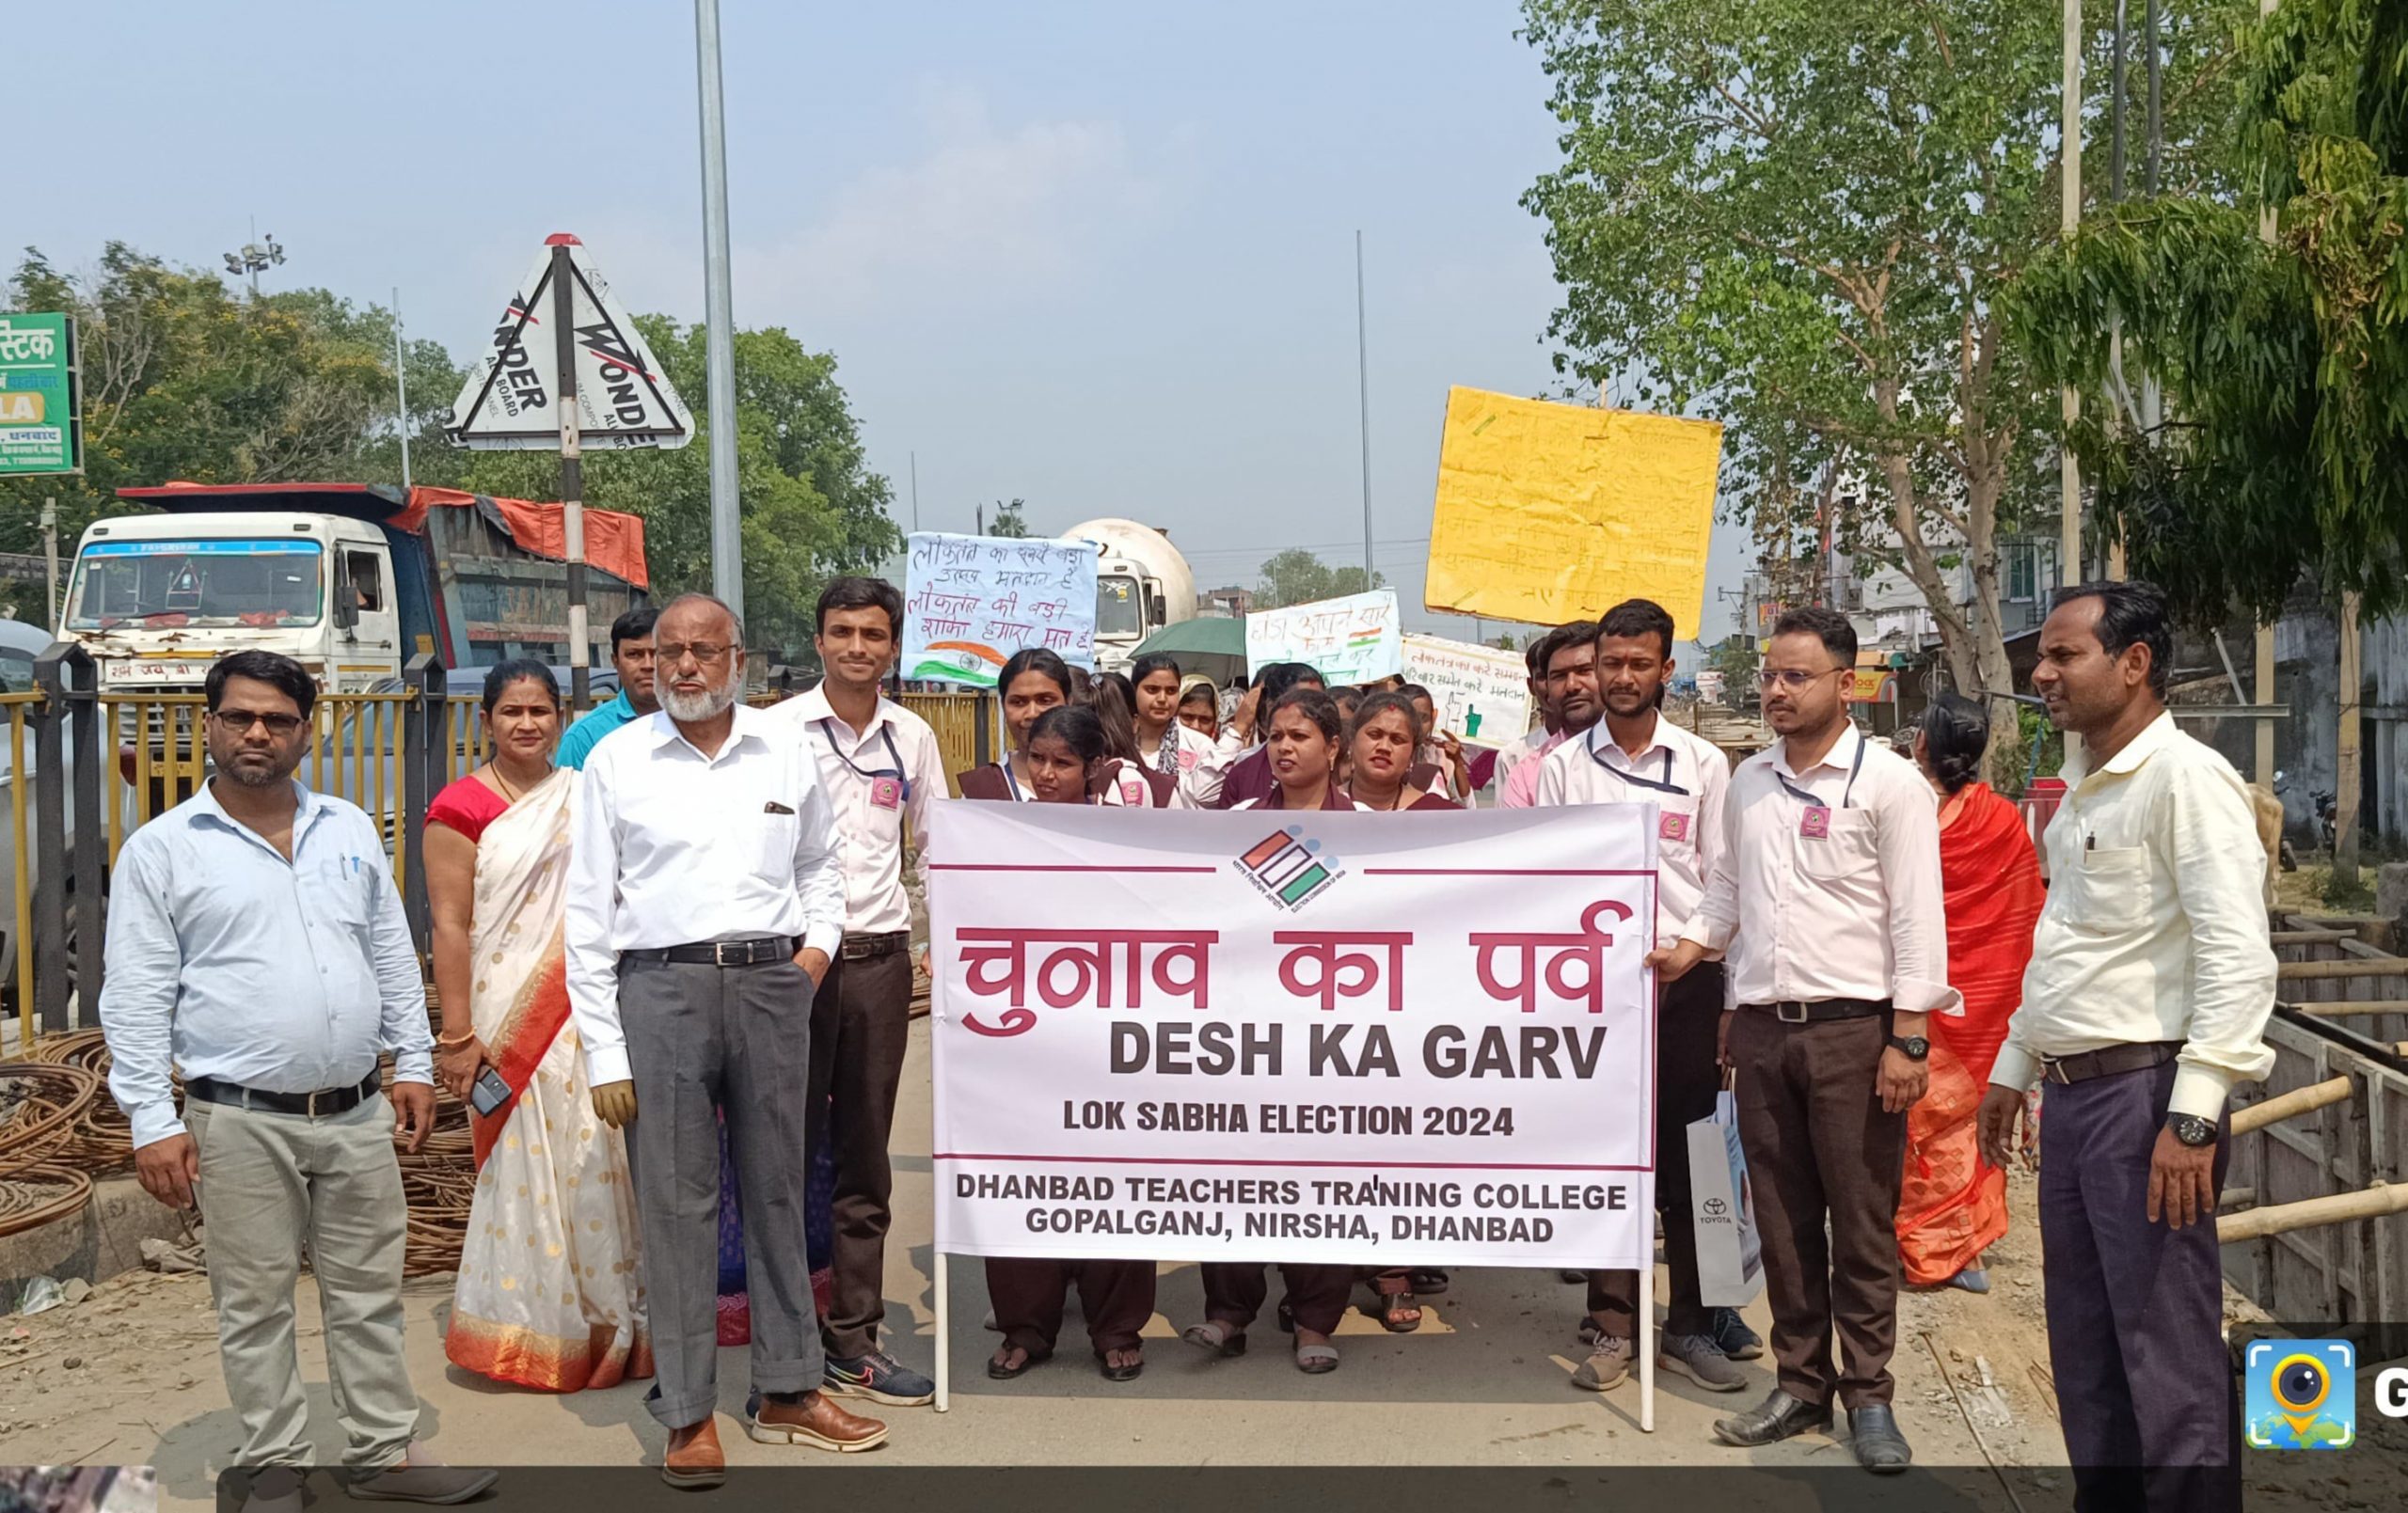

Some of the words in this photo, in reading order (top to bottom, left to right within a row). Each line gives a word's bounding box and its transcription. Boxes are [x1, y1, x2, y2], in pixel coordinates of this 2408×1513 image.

[496, 378, 519, 418] BOARD
[991, 591, 1018, 619] की
[956, 927, 1219, 1037] चुनाव
[1274, 930, 1413, 1012] का
[1469, 899, 1634, 1015] पर्व
[1110, 1021, 1283, 1077] DESH
[1309, 1023, 1402, 1078] KA
[1422, 1025, 1608, 1080] GARV
[1064, 1100, 1126, 1130] LOK
[1136, 1102, 1250, 1133] SABHA
[1259, 1104, 1413, 1136] ELECTION
[1422, 1107, 1515, 1137] 2024
[957, 1174, 1115, 1201] DHANBAD
[1125, 1176, 1301, 1206] TEACHERS
[1473, 1183, 1627, 1211] COLLEGE
[1025, 1207, 1233, 1243] GOPALGANJ,
[1244, 1212, 1380, 1246] NIRSHA,
[1391, 1215, 1554, 1243] DHANBAD
[1700, 1216, 1732, 1224] TOYOTA
